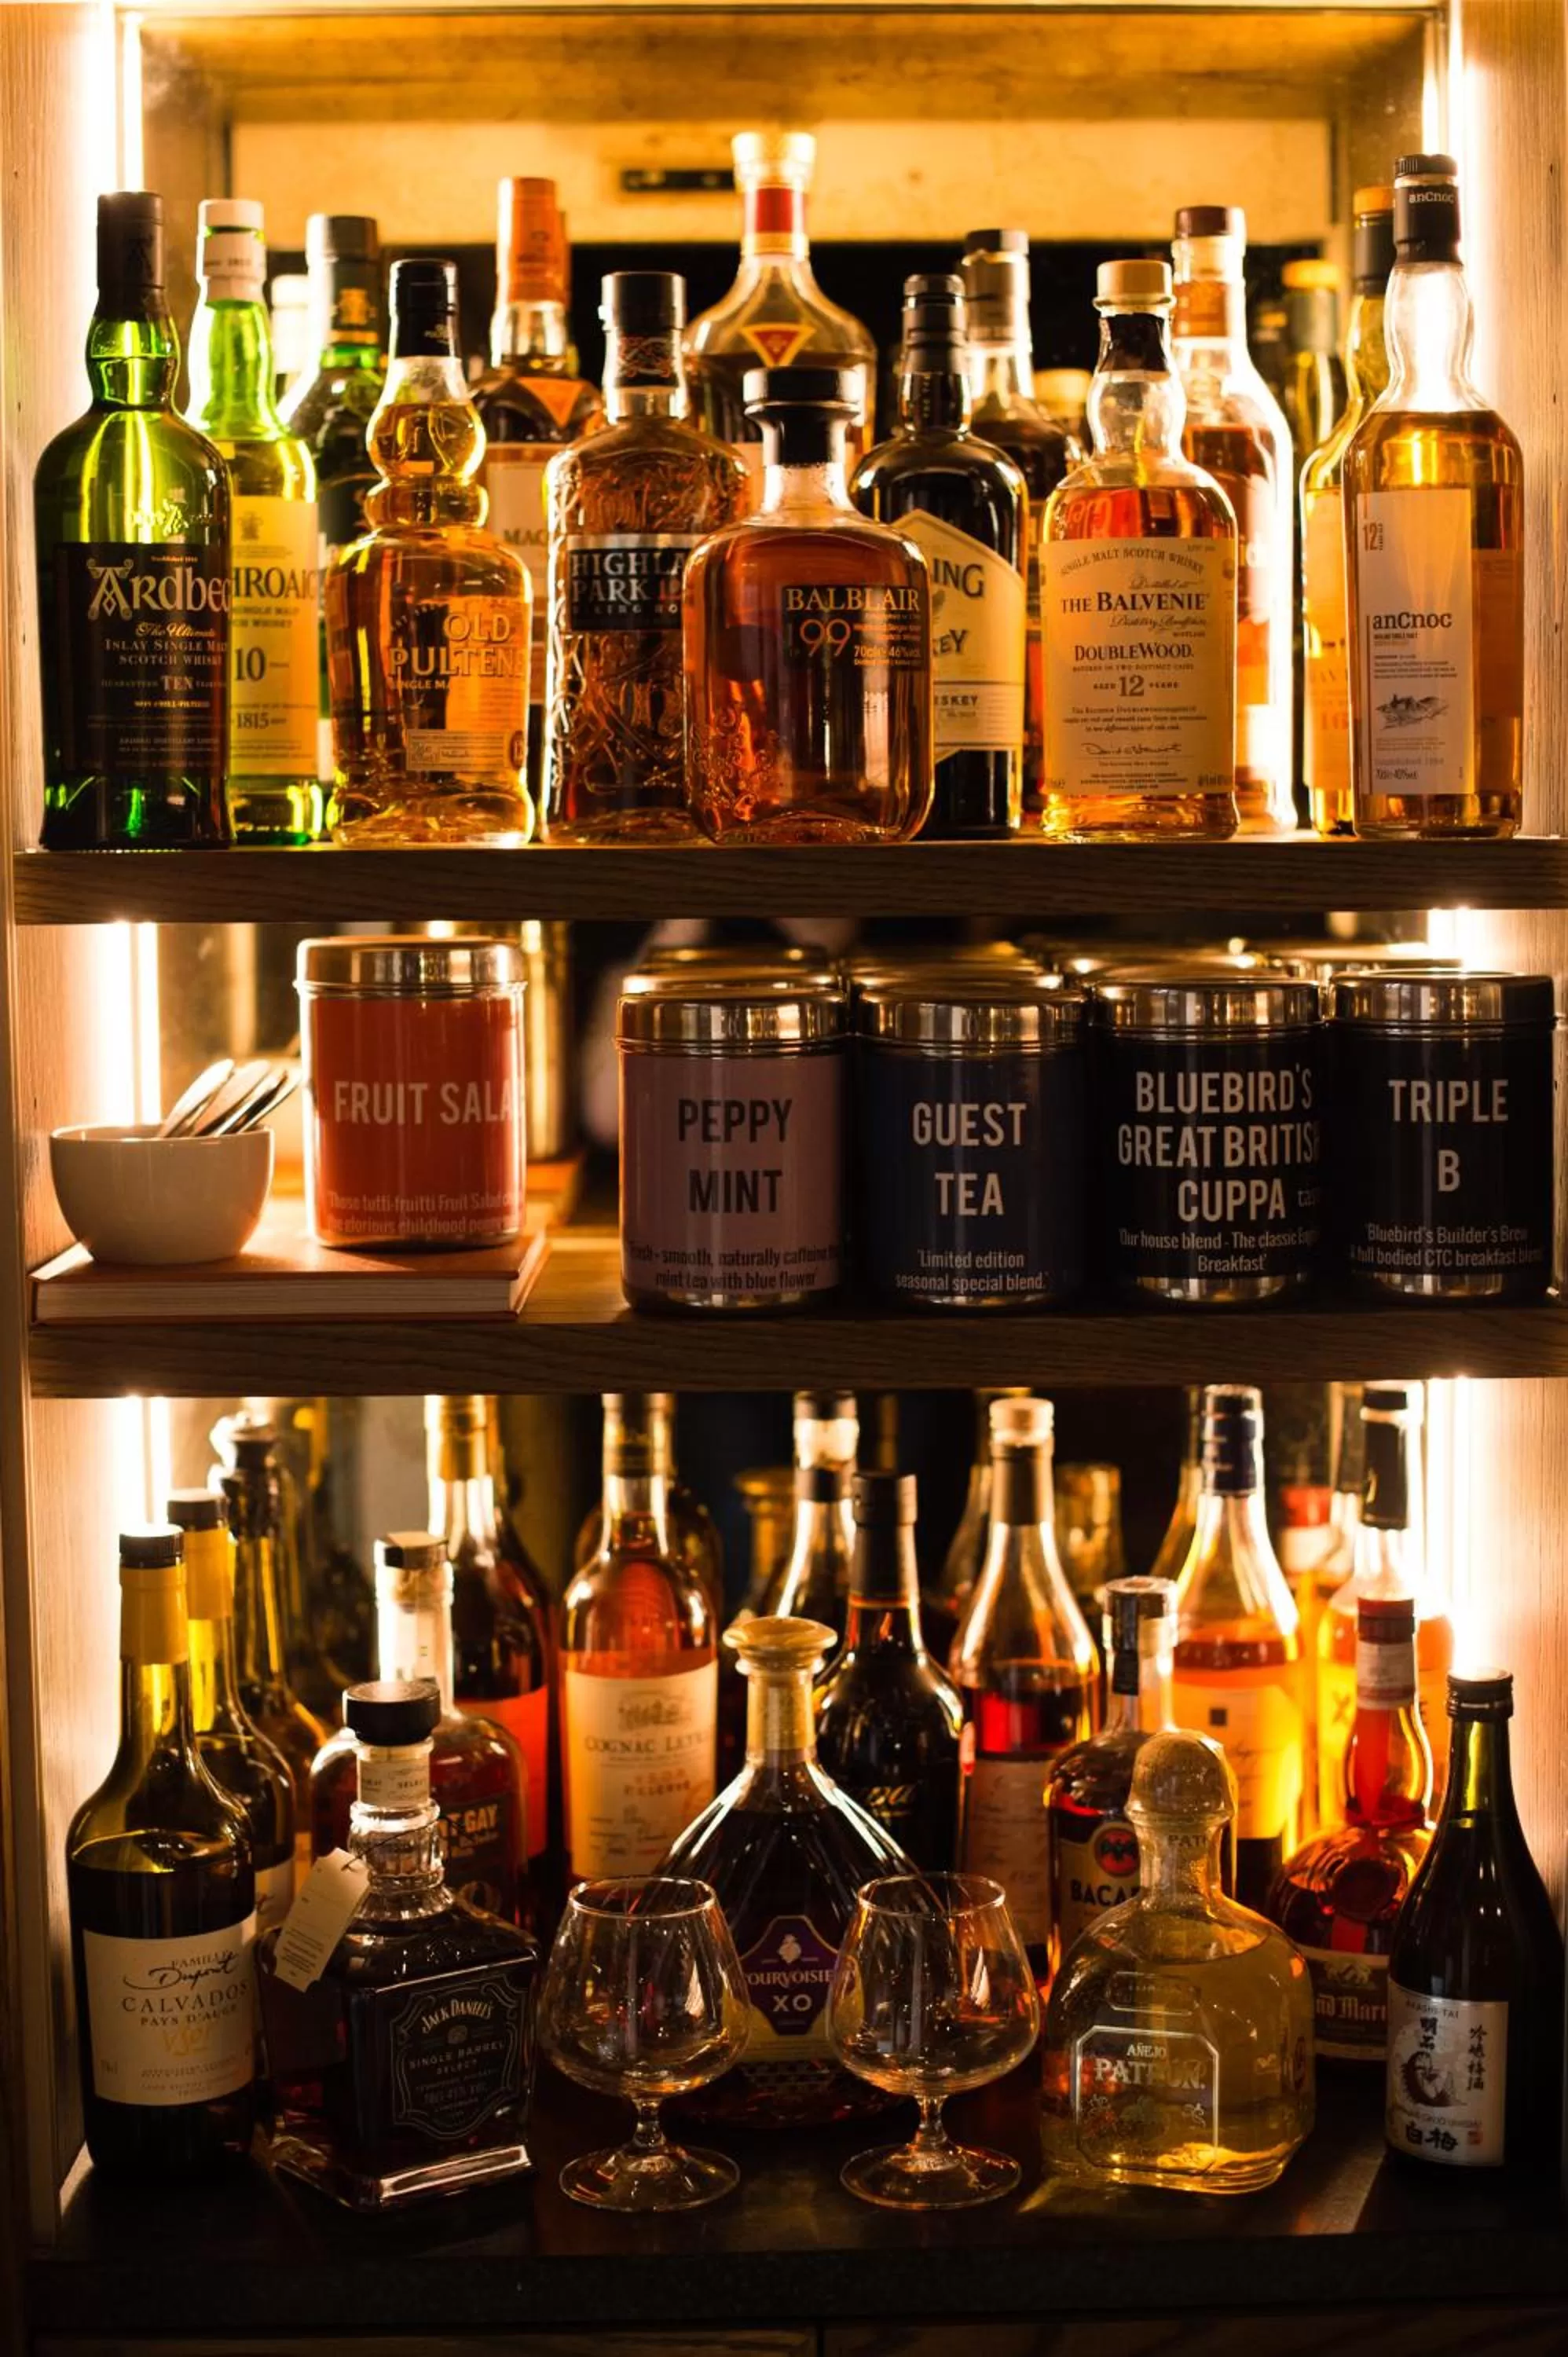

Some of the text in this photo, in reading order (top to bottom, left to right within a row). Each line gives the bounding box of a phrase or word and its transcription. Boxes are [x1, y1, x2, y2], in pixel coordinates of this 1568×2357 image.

[570, 552, 685, 577] HIGHLA
[1092, 548, 1119, 563] MALT
[1123, 547, 1165, 561] SCOTCH
[571, 577, 652, 605] PARK
[786, 586, 920, 611] BALBLAIR
[1061, 591, 1207, 615] THE BALVENIE
[443, 614, 512, 643] OLD
[1372, 611, 1453, 629] anCnoc
[235, 647, 266, 682] 10
[1118, 674, 1145, 697] 12
[1136, 1062, 1313, 1114] BLUEBIRD'S
[1387, 1079, 1509, 1124] TRIPLE
[334, 1080, 429, 1126] FRUIT
[678, 1098, 793, 1143] PEPPY
[912, 1102, 1027, 1146] GUEST
[1118, 1123, 1217, 1168] GREAT
[1437, 1149, 1461, 1193] B
[688, 1168, 782, 1214] MINT
[934, 1172, 1004, 1215] TEA
[1178, 1179, 1287, 1222] CUPPA
[1140, 1230, 1179, 1250] house
[1181, 1230, 1222, 1251] blend
[1231, 1230, 1255, 1250] The
[1258, 1230, 1296, 1248] classic
[1436, 1226, 1499, 1244] Builder's
[720, 1247, 779, 1267] naturally
[975, 1249, 1025, 1269] edition
[1376, 1245, 1422, 1266] bodied
[1454, 1247, 1517, 1268] breakfast
[655, 1268, 683, 1288] mint
[746, 1271, 776, 1289] blue
[895, 1272, 949, 1292] seasonal
[951, 1274, 1004, 1294] special
[122, 1979, 249, 2013] CALVADOS
